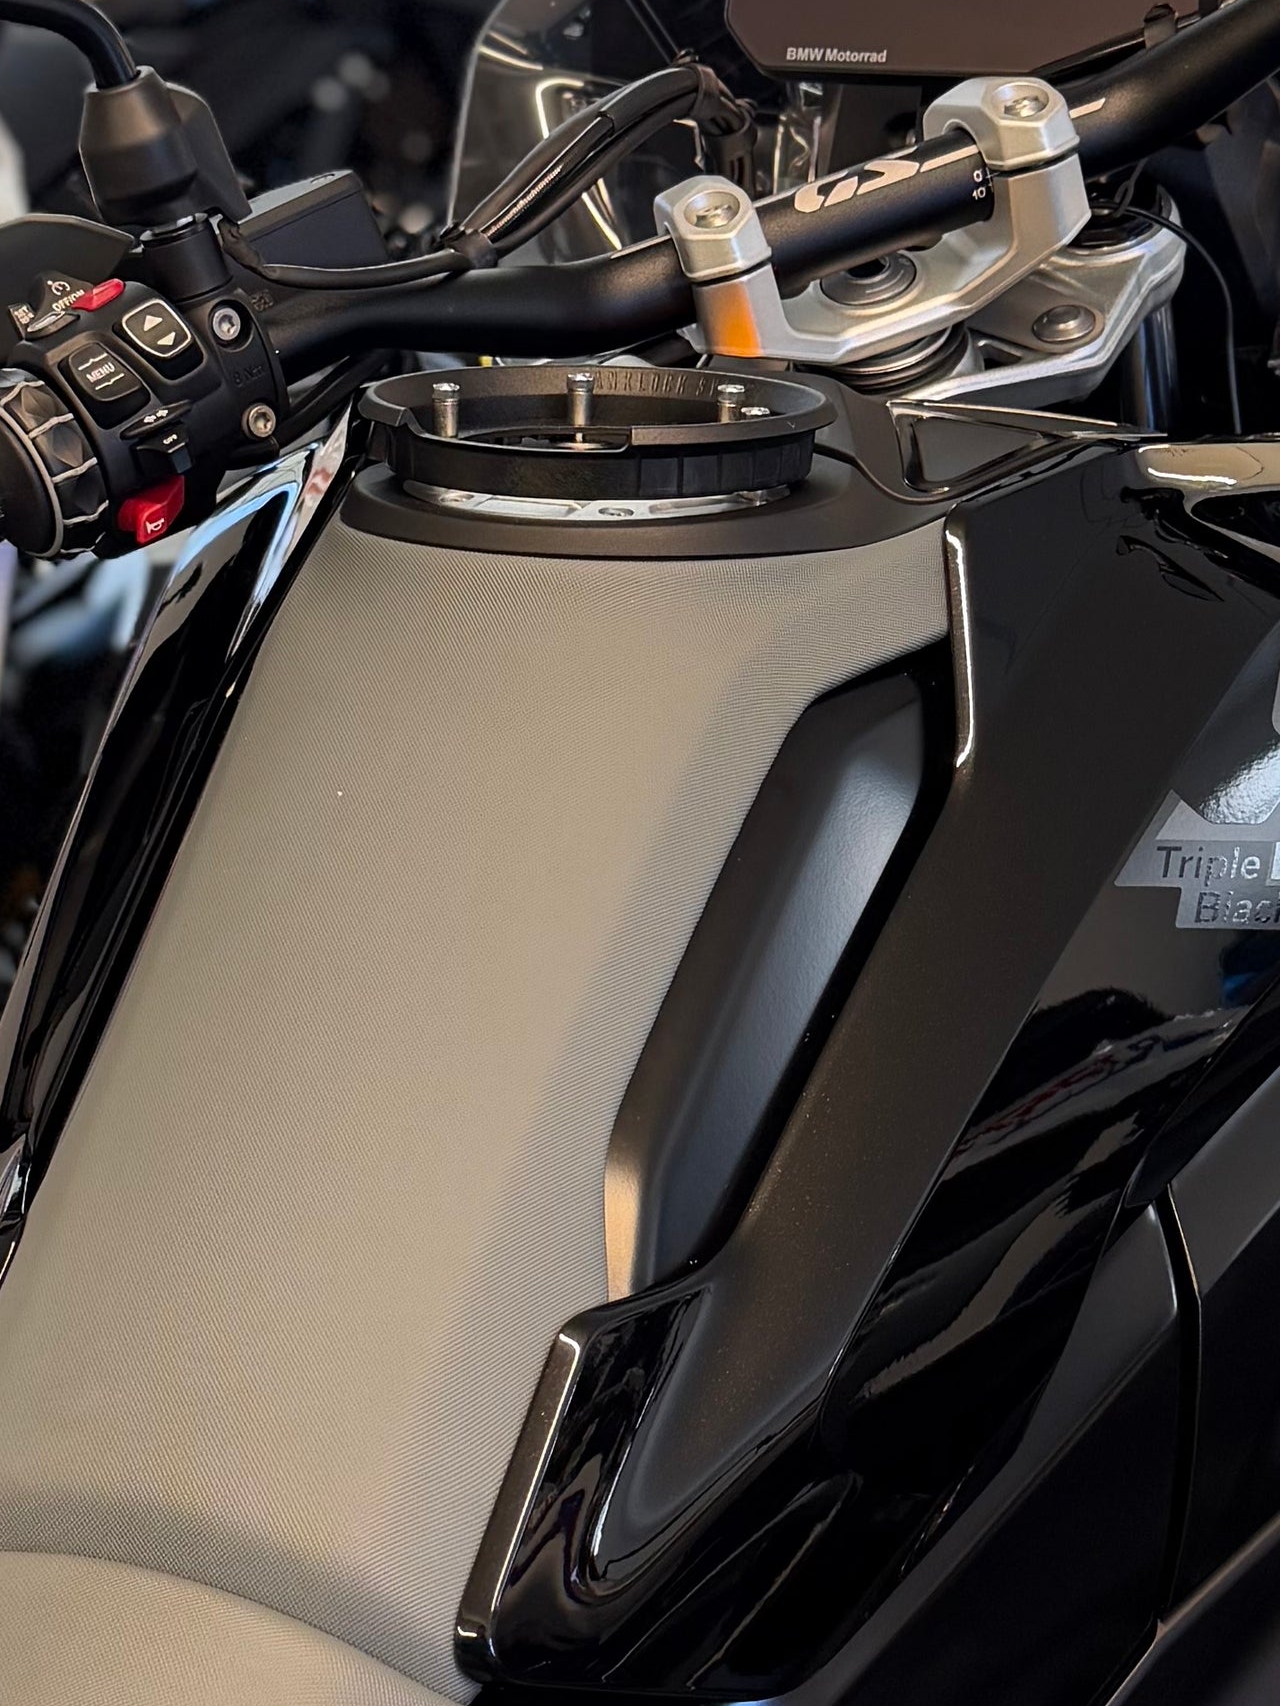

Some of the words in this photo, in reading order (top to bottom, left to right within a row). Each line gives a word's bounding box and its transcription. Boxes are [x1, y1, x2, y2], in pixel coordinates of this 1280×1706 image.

[786, 47, 824, 61] BMW
[825, 48, 887, 63] Motorrad
[86, 362, 115, 383] MENU
[593, 370, 687, 396] ANKLOCK
[1156, 846, 1261, 887] Triple
